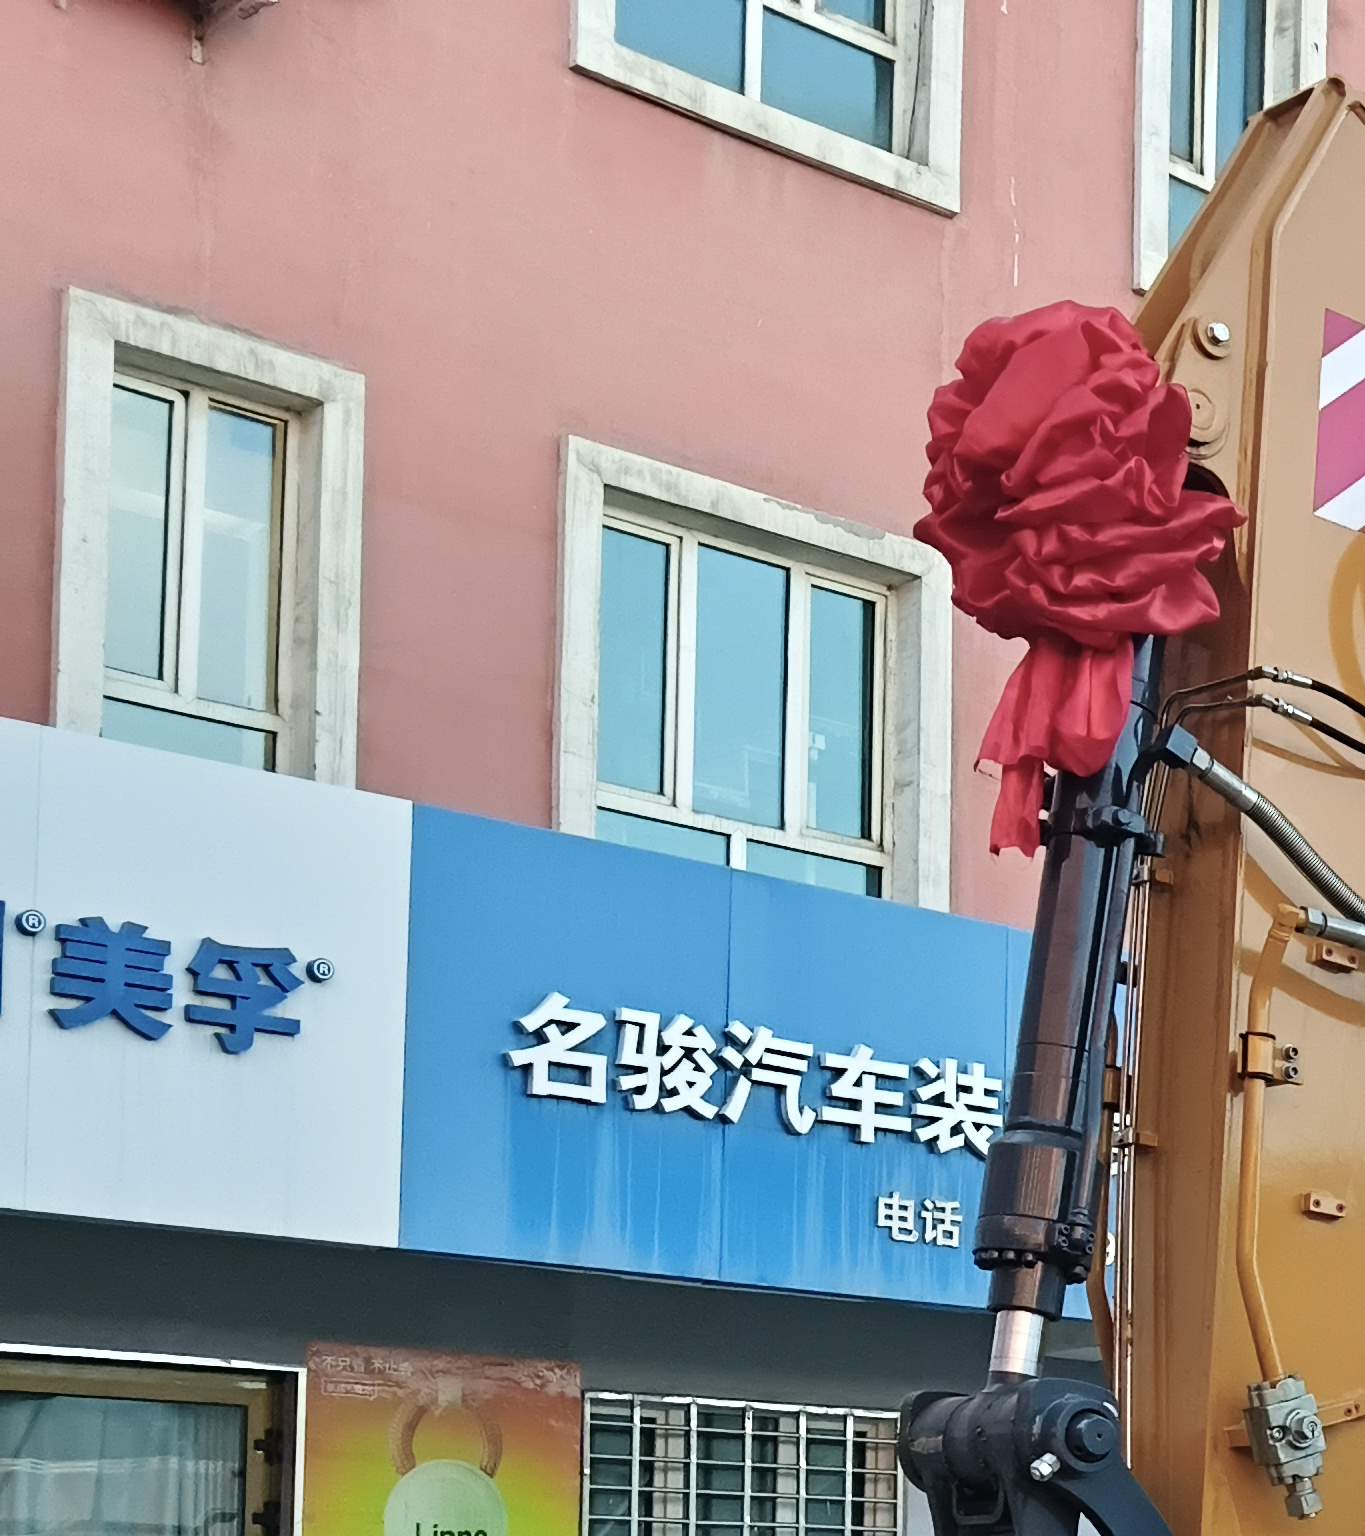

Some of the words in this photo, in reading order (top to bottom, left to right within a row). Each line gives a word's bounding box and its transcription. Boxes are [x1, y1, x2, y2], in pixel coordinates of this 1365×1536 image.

[47, 915, 305, 1056] 美孚
[505, 990, 1002, 1157] 名骏汽车装
[876, 1190, 963, 1249] 电话
